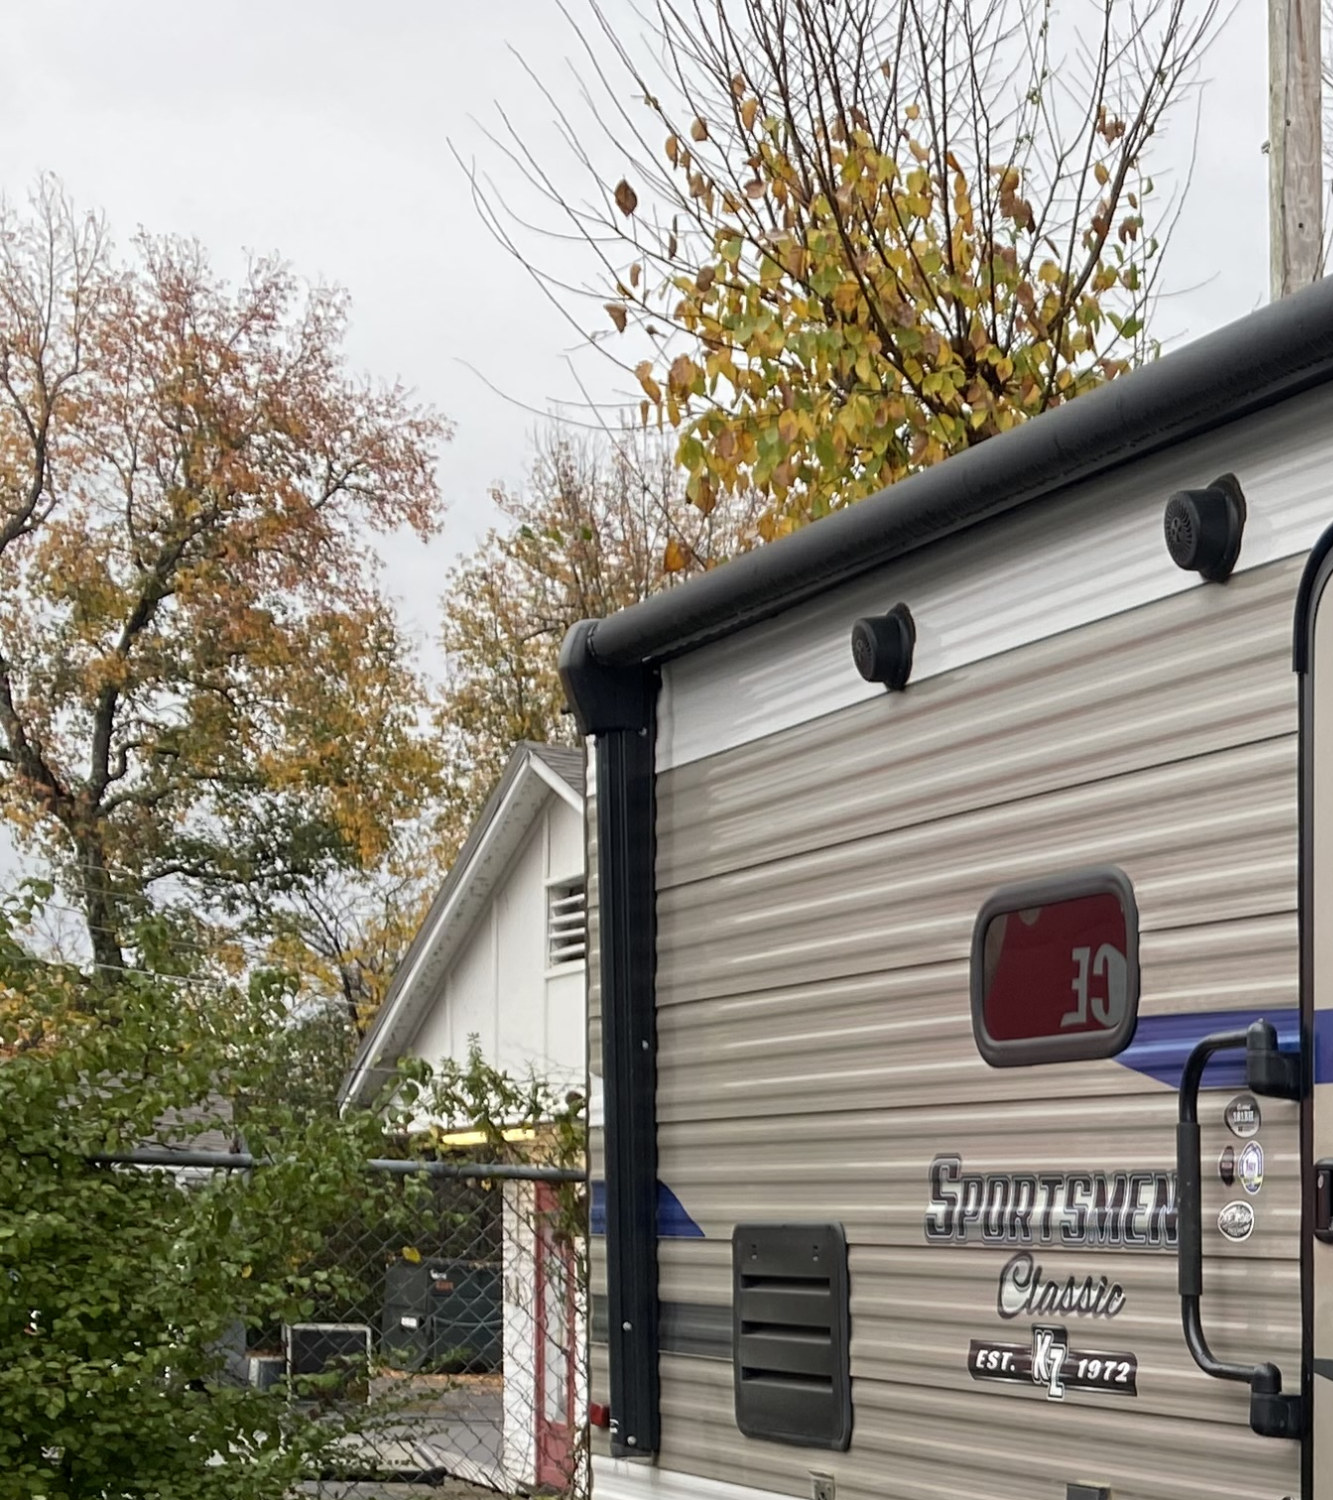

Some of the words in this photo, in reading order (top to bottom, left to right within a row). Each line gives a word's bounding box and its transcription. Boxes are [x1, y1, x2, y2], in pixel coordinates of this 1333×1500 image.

[997, 1250, 1126, 1320] Classic
[975, 1348, 1016, 1373] EST.
[1077, 1357, 1132, 1383] 1972
